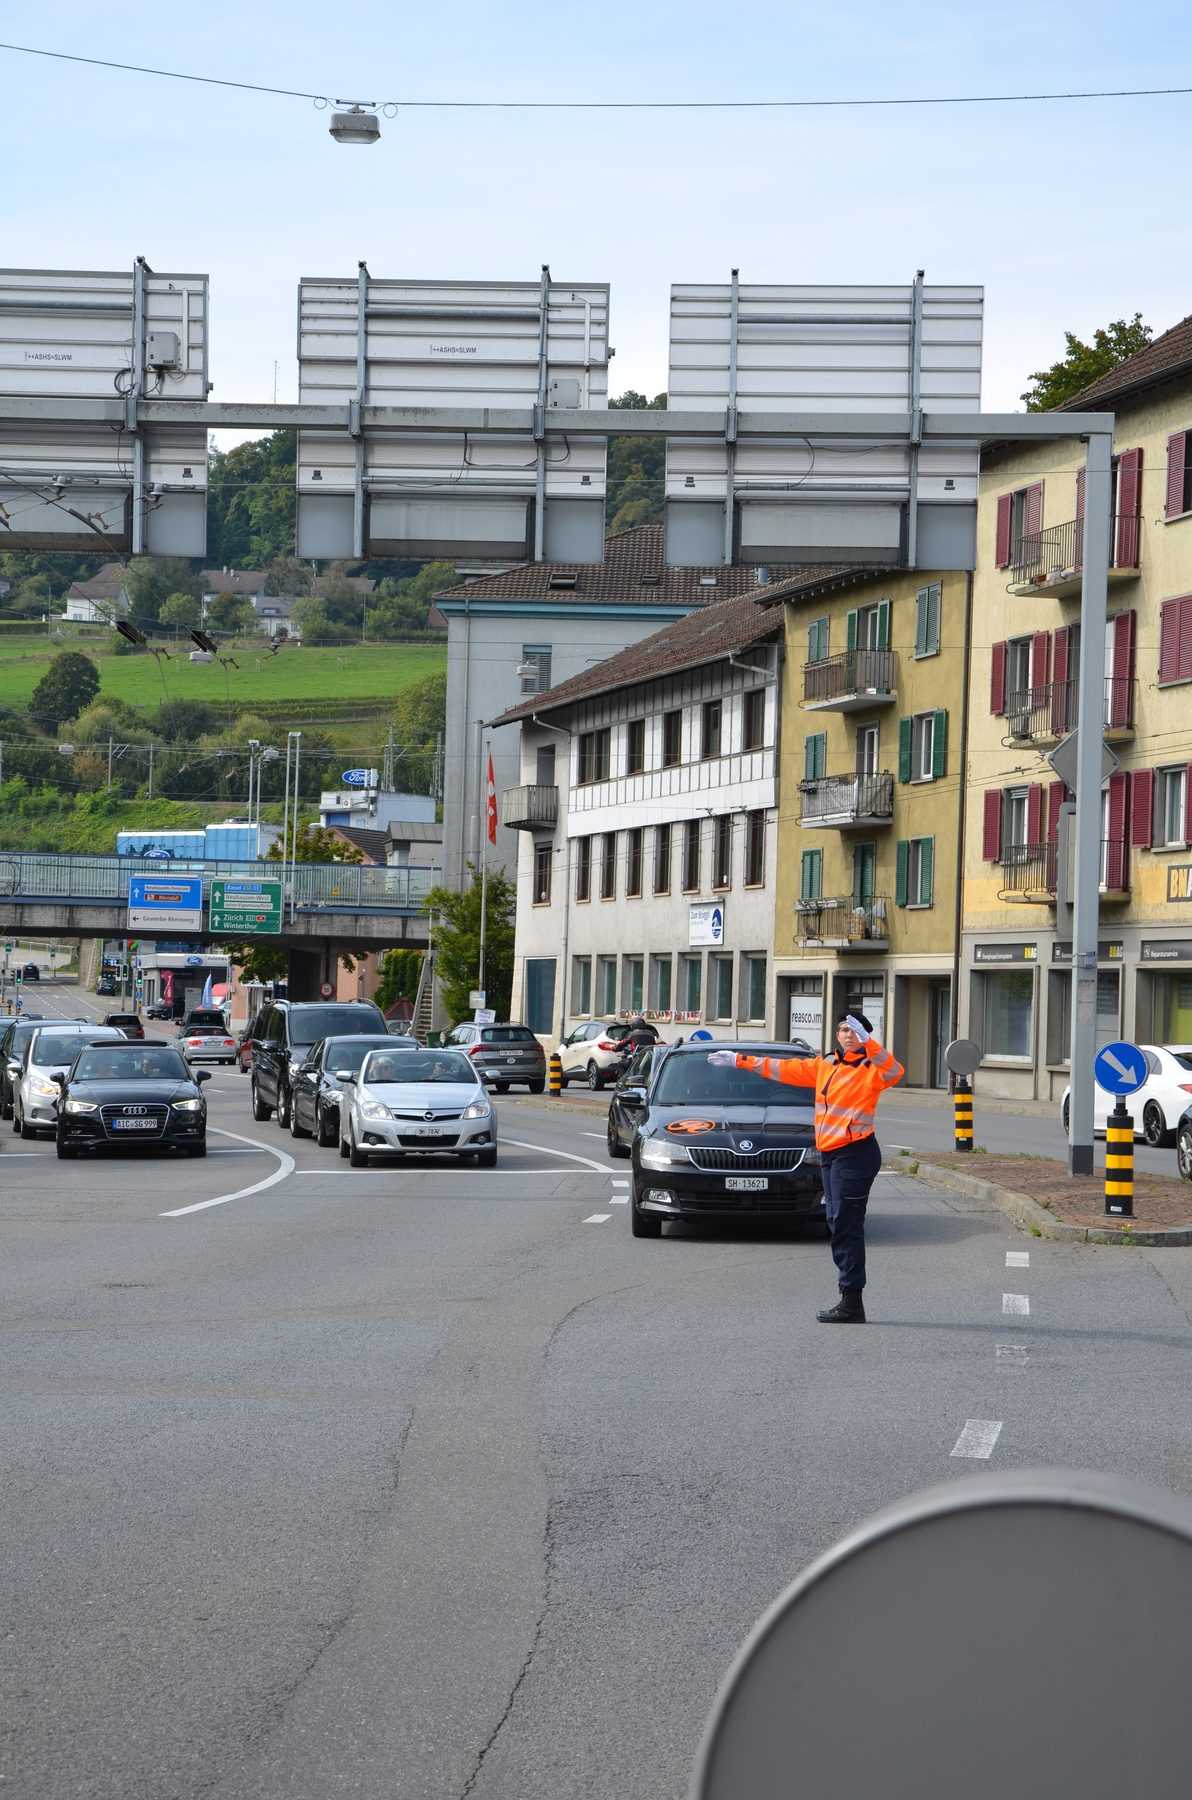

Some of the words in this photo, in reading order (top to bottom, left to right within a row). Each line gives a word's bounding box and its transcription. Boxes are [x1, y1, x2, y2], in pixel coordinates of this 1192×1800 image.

[167, 916, 194, 924] Rheinweg
[728, 1179, 738, 1188] SH
[743, 1179, 765, 1188] 13621
